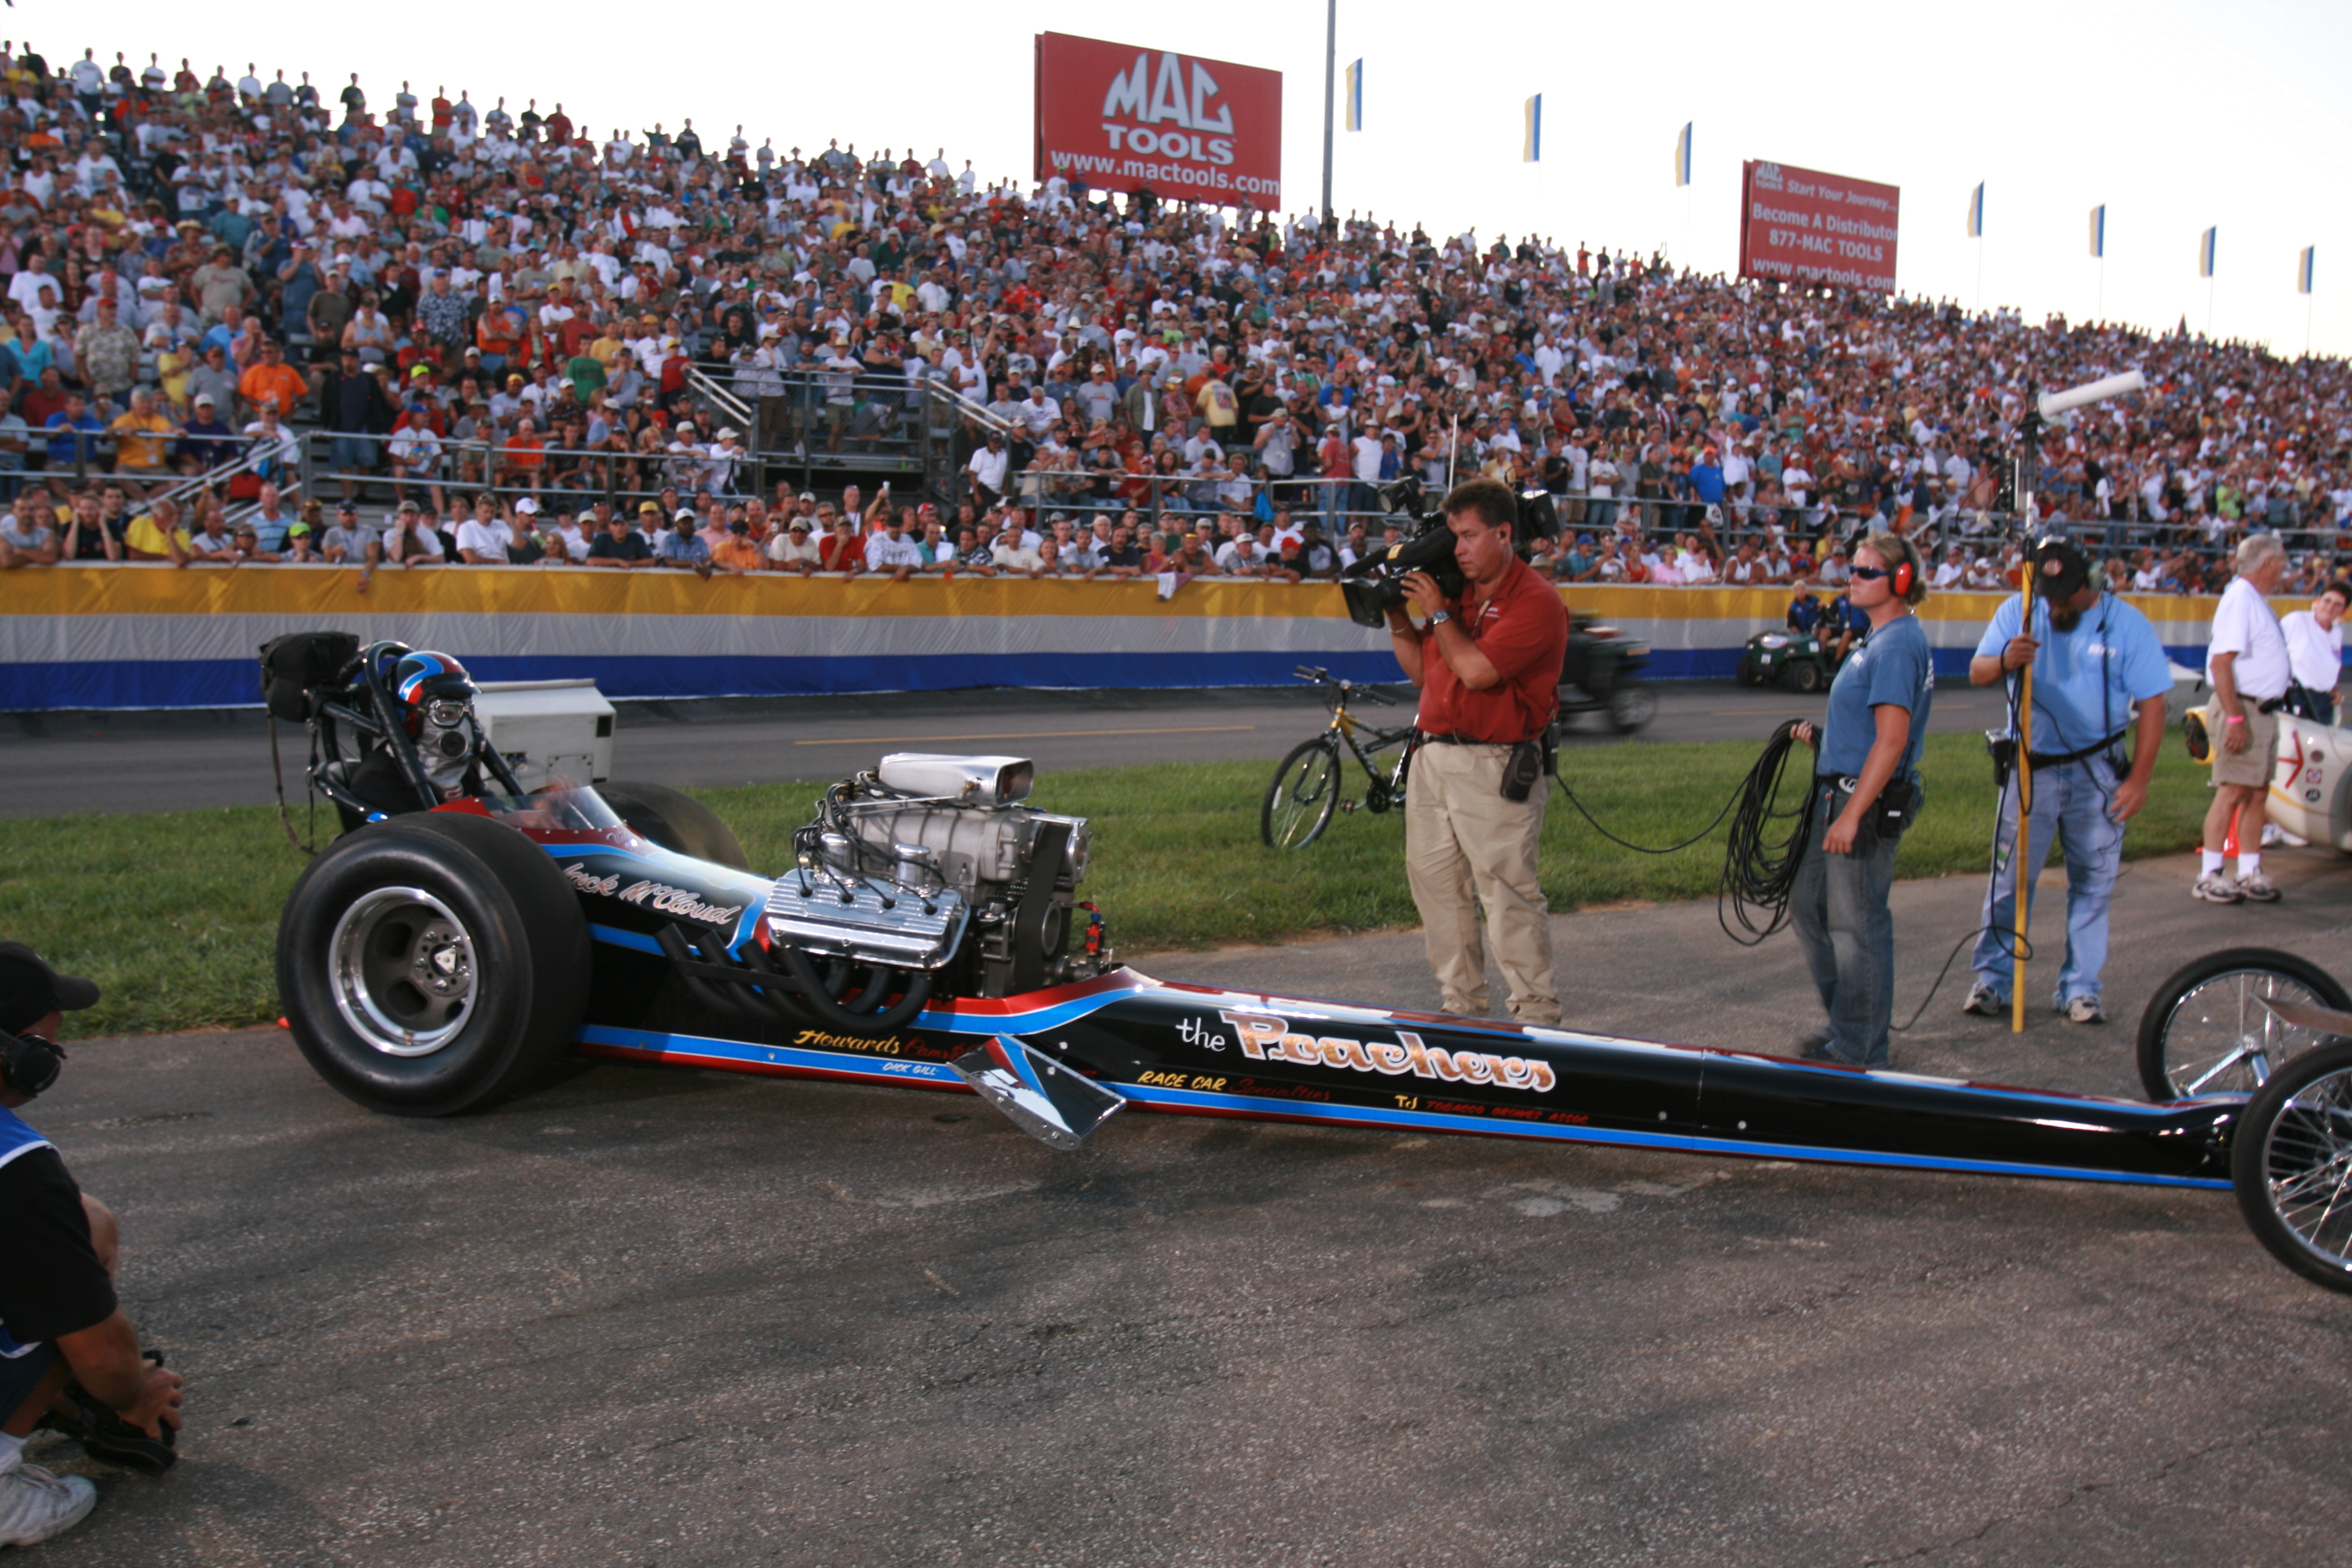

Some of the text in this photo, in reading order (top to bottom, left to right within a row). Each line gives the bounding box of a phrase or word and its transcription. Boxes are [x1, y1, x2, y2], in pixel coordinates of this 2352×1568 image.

[1102, 51, 1233, 134] MAC
[1102, 123, 1233, 164] TOOLS
[1050, 150, 1279, 194] www.mactools.com
[1755, 162, 1782, 181] MAC
[1787, 180, 1814, 196] Start
[1818, 186, 1843, 200] Your
[1753, 203, 1896, 240] Become A Distributor
[1769, 229, 1882, 261] 877-MAC TOOLS
[1753, 258, 1893, 290] wwwmactoolscom
[793, 1030, 900, 1053] Howards
[1175, 1010, 1555, 1091] the Poachers
[882, 1062, 935, 1074] DICK GILL
[1137, 1070, 1187, 1086] RACE
[1191, 1076, 1226, 1090] CAR
